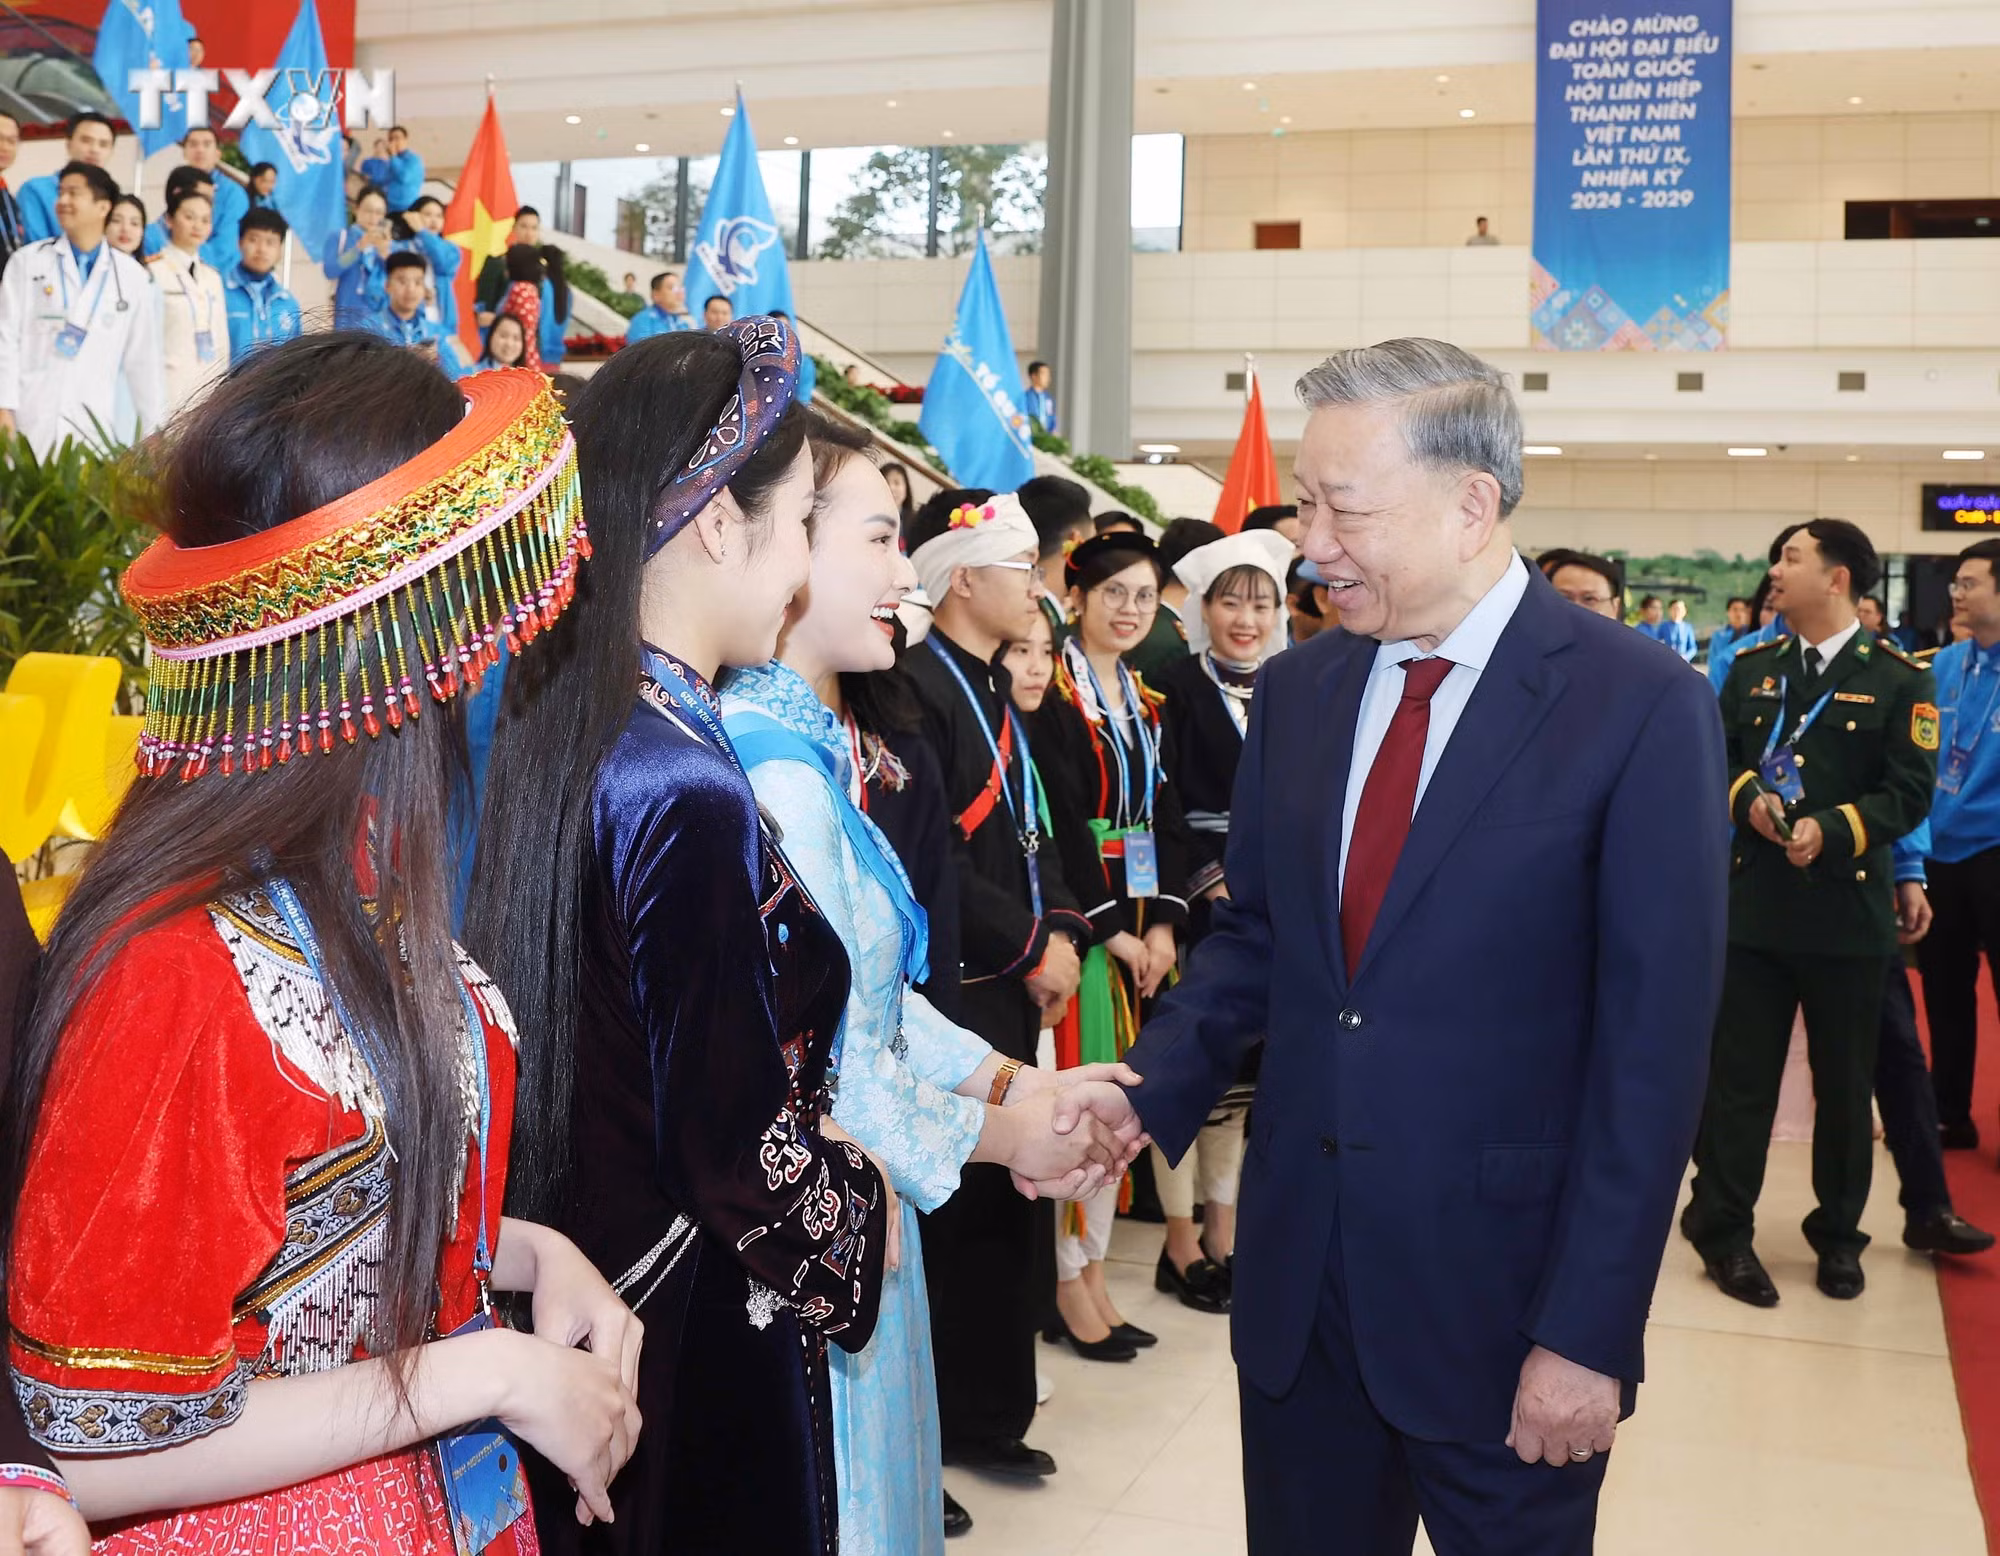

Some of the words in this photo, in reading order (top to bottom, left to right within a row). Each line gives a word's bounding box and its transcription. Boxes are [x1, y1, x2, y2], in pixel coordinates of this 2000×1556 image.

[1569, 14, 1628, 37] CHÀO
[1632, 13, 1699, 34] MỪNG
[1550, 42, 1585, 61] ĐẠI
[1589, 38, 1629, 60] HỘI
[1632, 38, 1669, 57] ĐẠI
[1673, 31, 1719, 54] BIỂU
[1572, 59, 1629, 80] TOÀN
[1634, 54, 1696, 78] QUỐC
[1565, 82, 1604, 104] HỘI
[1608, 80, 1652, 100] LIÊN
[1656, 78, 1702, 100] HIỆP
[1570, 105, 1641, 123] THANH
[1645, 101, 1697, 120] NIÊN
[1585, 124, 1627, 146] VIỆT
[1630, 125, 1681, 142] NAM
[1572, 144, 1614, 166] LẦN
[1618, 143, 1661, 164] THỨ
[1664, 147, 1691, 165] IX,
[1581, 166, 1649, 189] NHIỆM
[1653, 165, 1684, 185] KỲ
[1570, 191, 1622, 209] 2024
[1641, 190, 1695, 208] 2029
[680, 691, 698, 708] 2029
[696, 708, 712, 724] 2024
